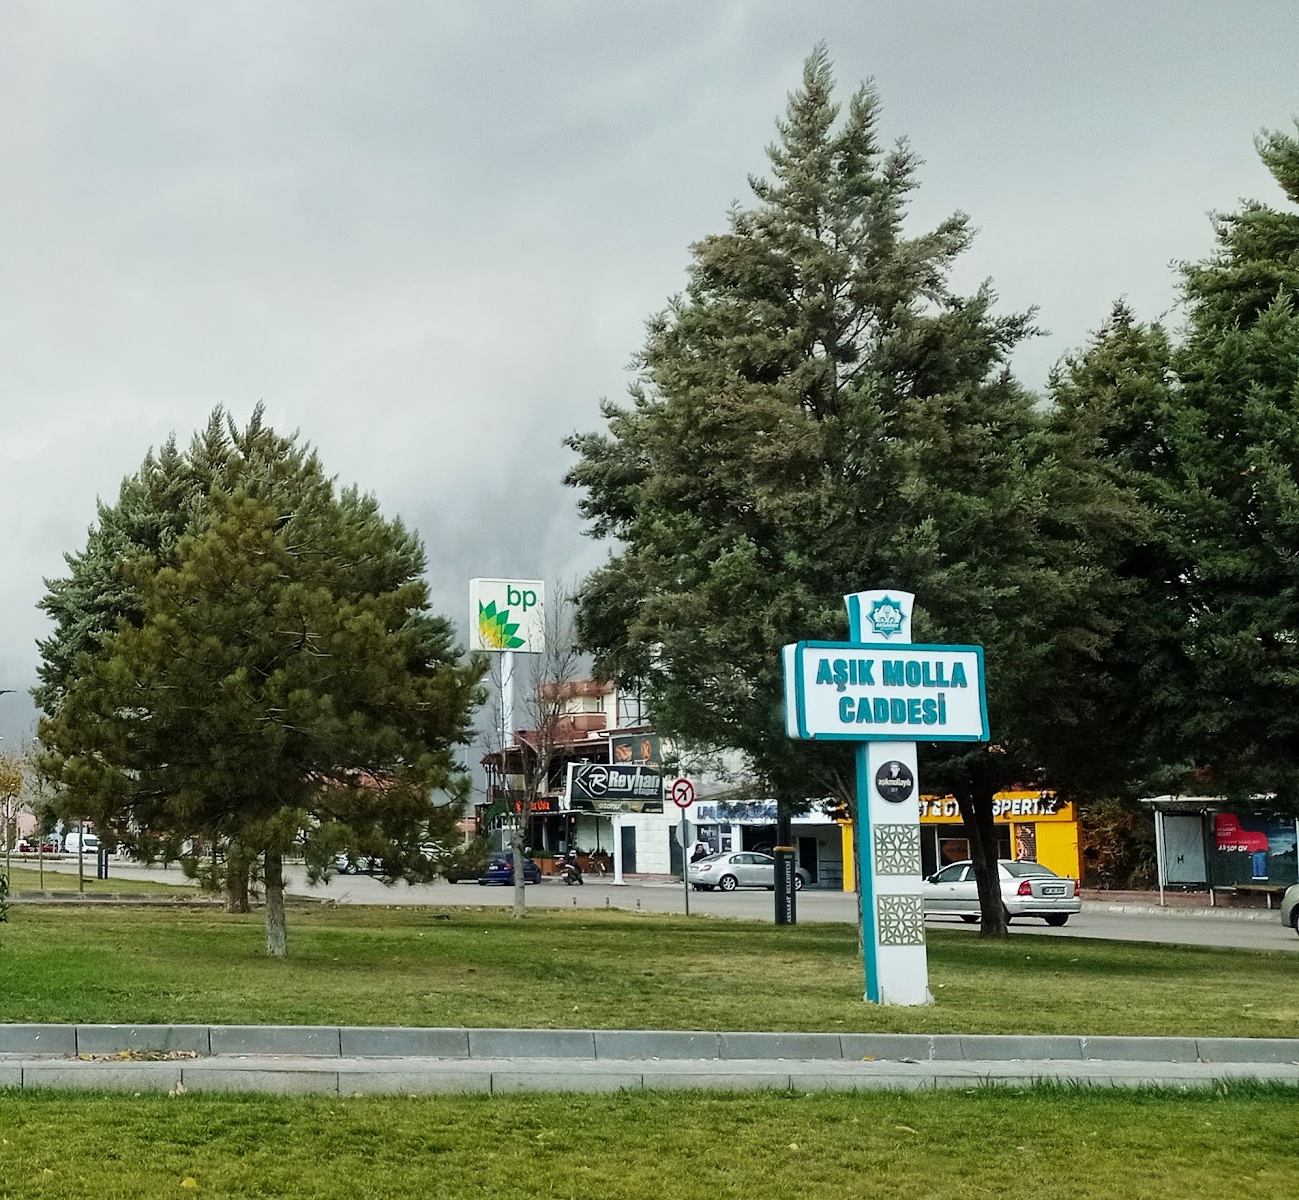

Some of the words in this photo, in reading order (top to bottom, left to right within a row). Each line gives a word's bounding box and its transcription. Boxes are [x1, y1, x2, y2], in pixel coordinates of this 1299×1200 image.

[507, 584, 537, 612] bp
[816, 658, 876, 692] AŞIK
[882, 659, 968, 688] MOLLA
[838, 692, 947, 725] CADDESİ
[608, 767, 661, 792] Reyhan
